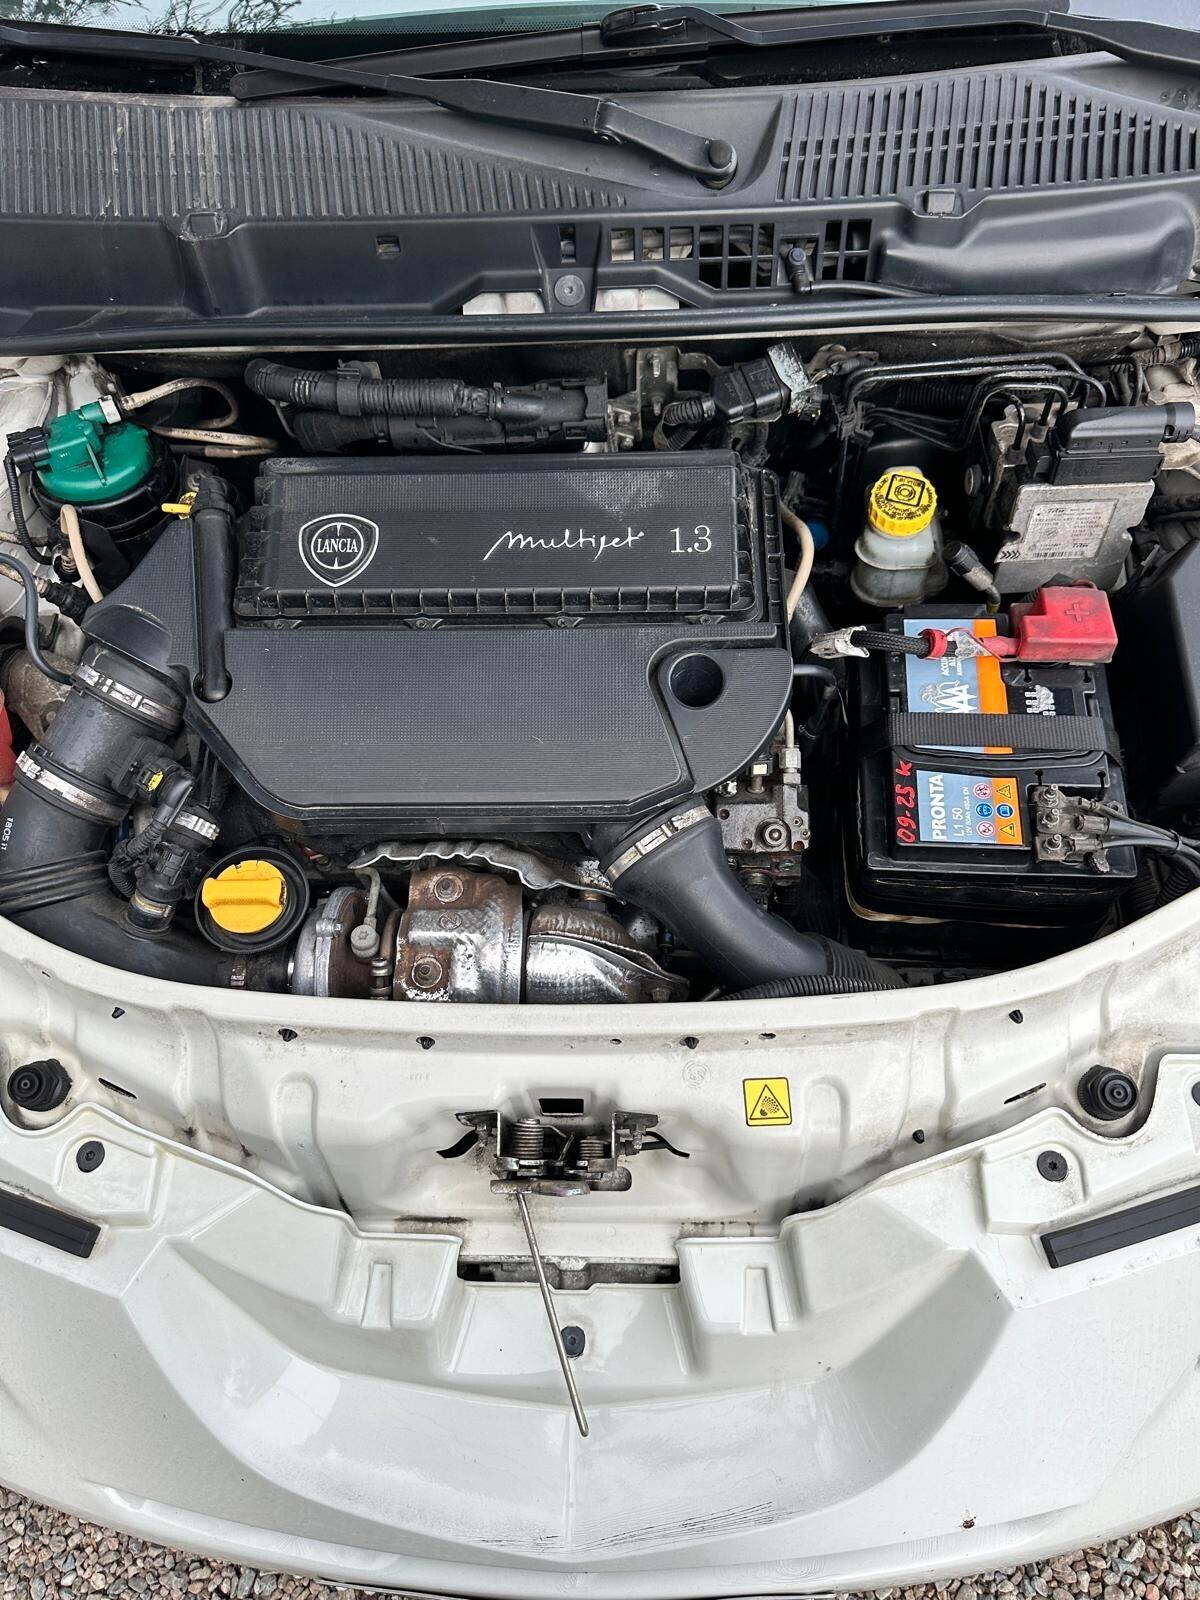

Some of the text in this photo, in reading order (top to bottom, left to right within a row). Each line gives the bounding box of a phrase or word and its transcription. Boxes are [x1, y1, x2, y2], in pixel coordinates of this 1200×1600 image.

[316, 538, 359, 553] LANCIA
[670, 524, 713, 553] 1.3
[895, 784, 917, 844] 09-25
[928, 774, 947, 841] PRONTA
[951, 807, 965, 837] L1 50
